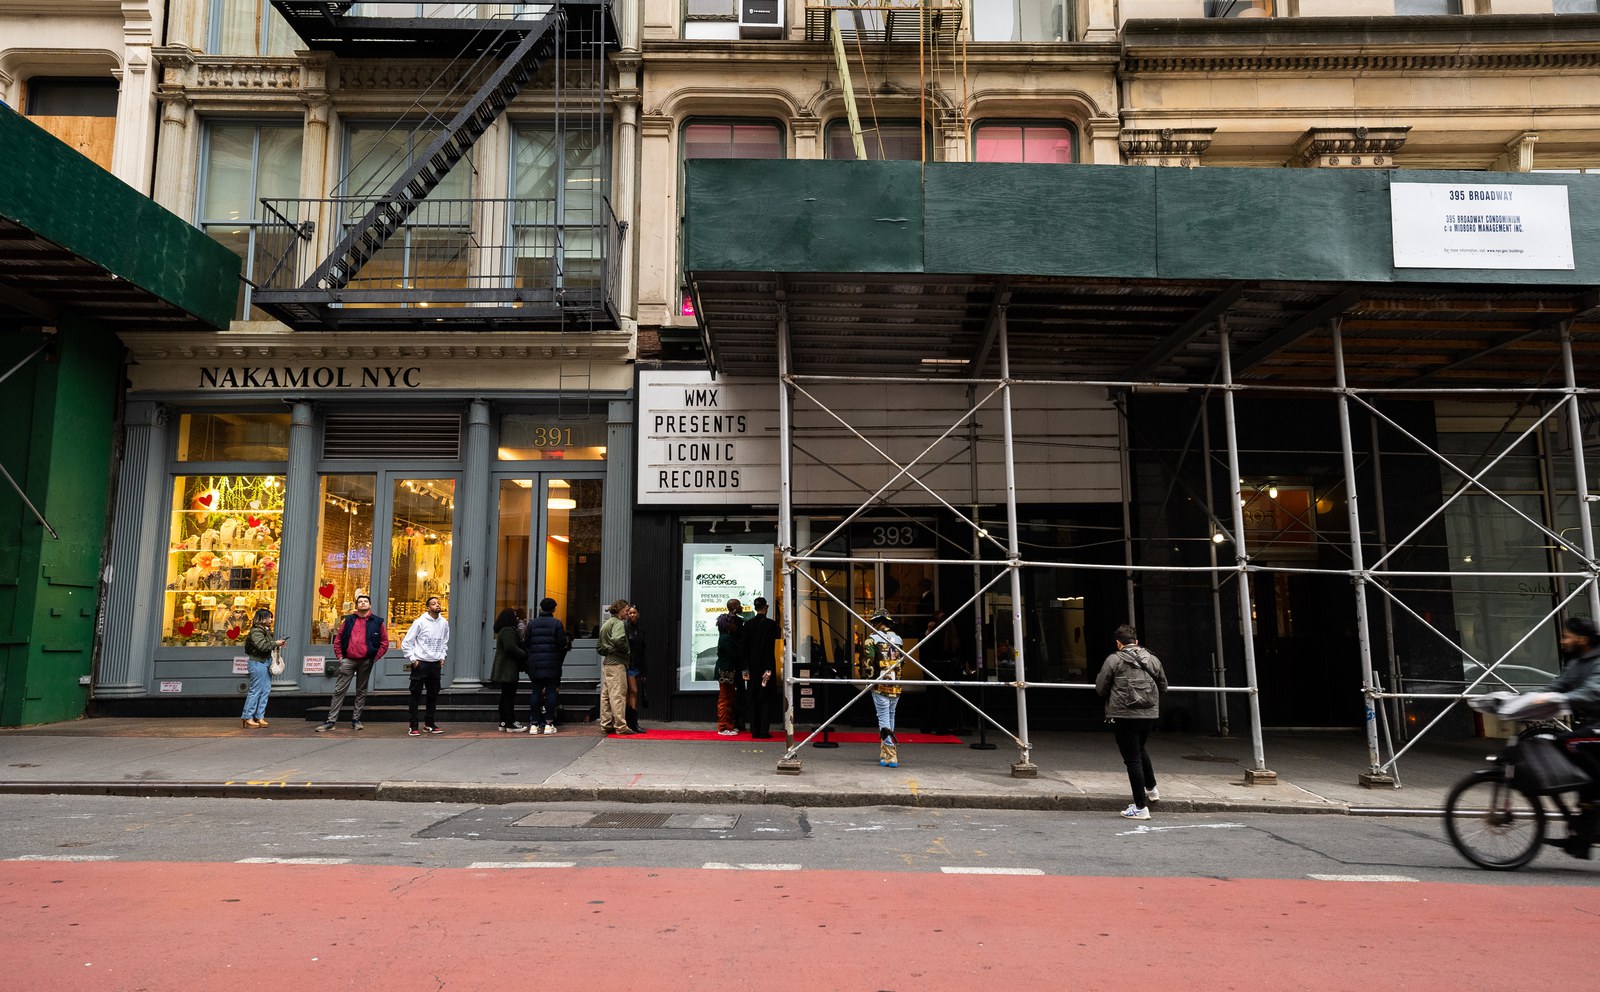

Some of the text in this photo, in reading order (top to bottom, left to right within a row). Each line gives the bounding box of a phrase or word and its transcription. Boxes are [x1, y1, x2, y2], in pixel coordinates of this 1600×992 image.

[1449, 190, 1513, 201] 395 BROADWAY
[1446, 215, 1521, 223] 395 BROADWAY CONDOMINIUM
[1477, 224, 1512, 232] MANAGEMENT
[199, 367, 421, 388] NAKAMOL NYC
[685, 389, 718, 406] WMX
[655, 415, 746, 433] PRESENTS
[534, 427, 574, 447] 391
[668, 443, 734, 461] ICONIC
[659, 470, 739, 488] RECORDS
[872, 526, 914, 546] 393
